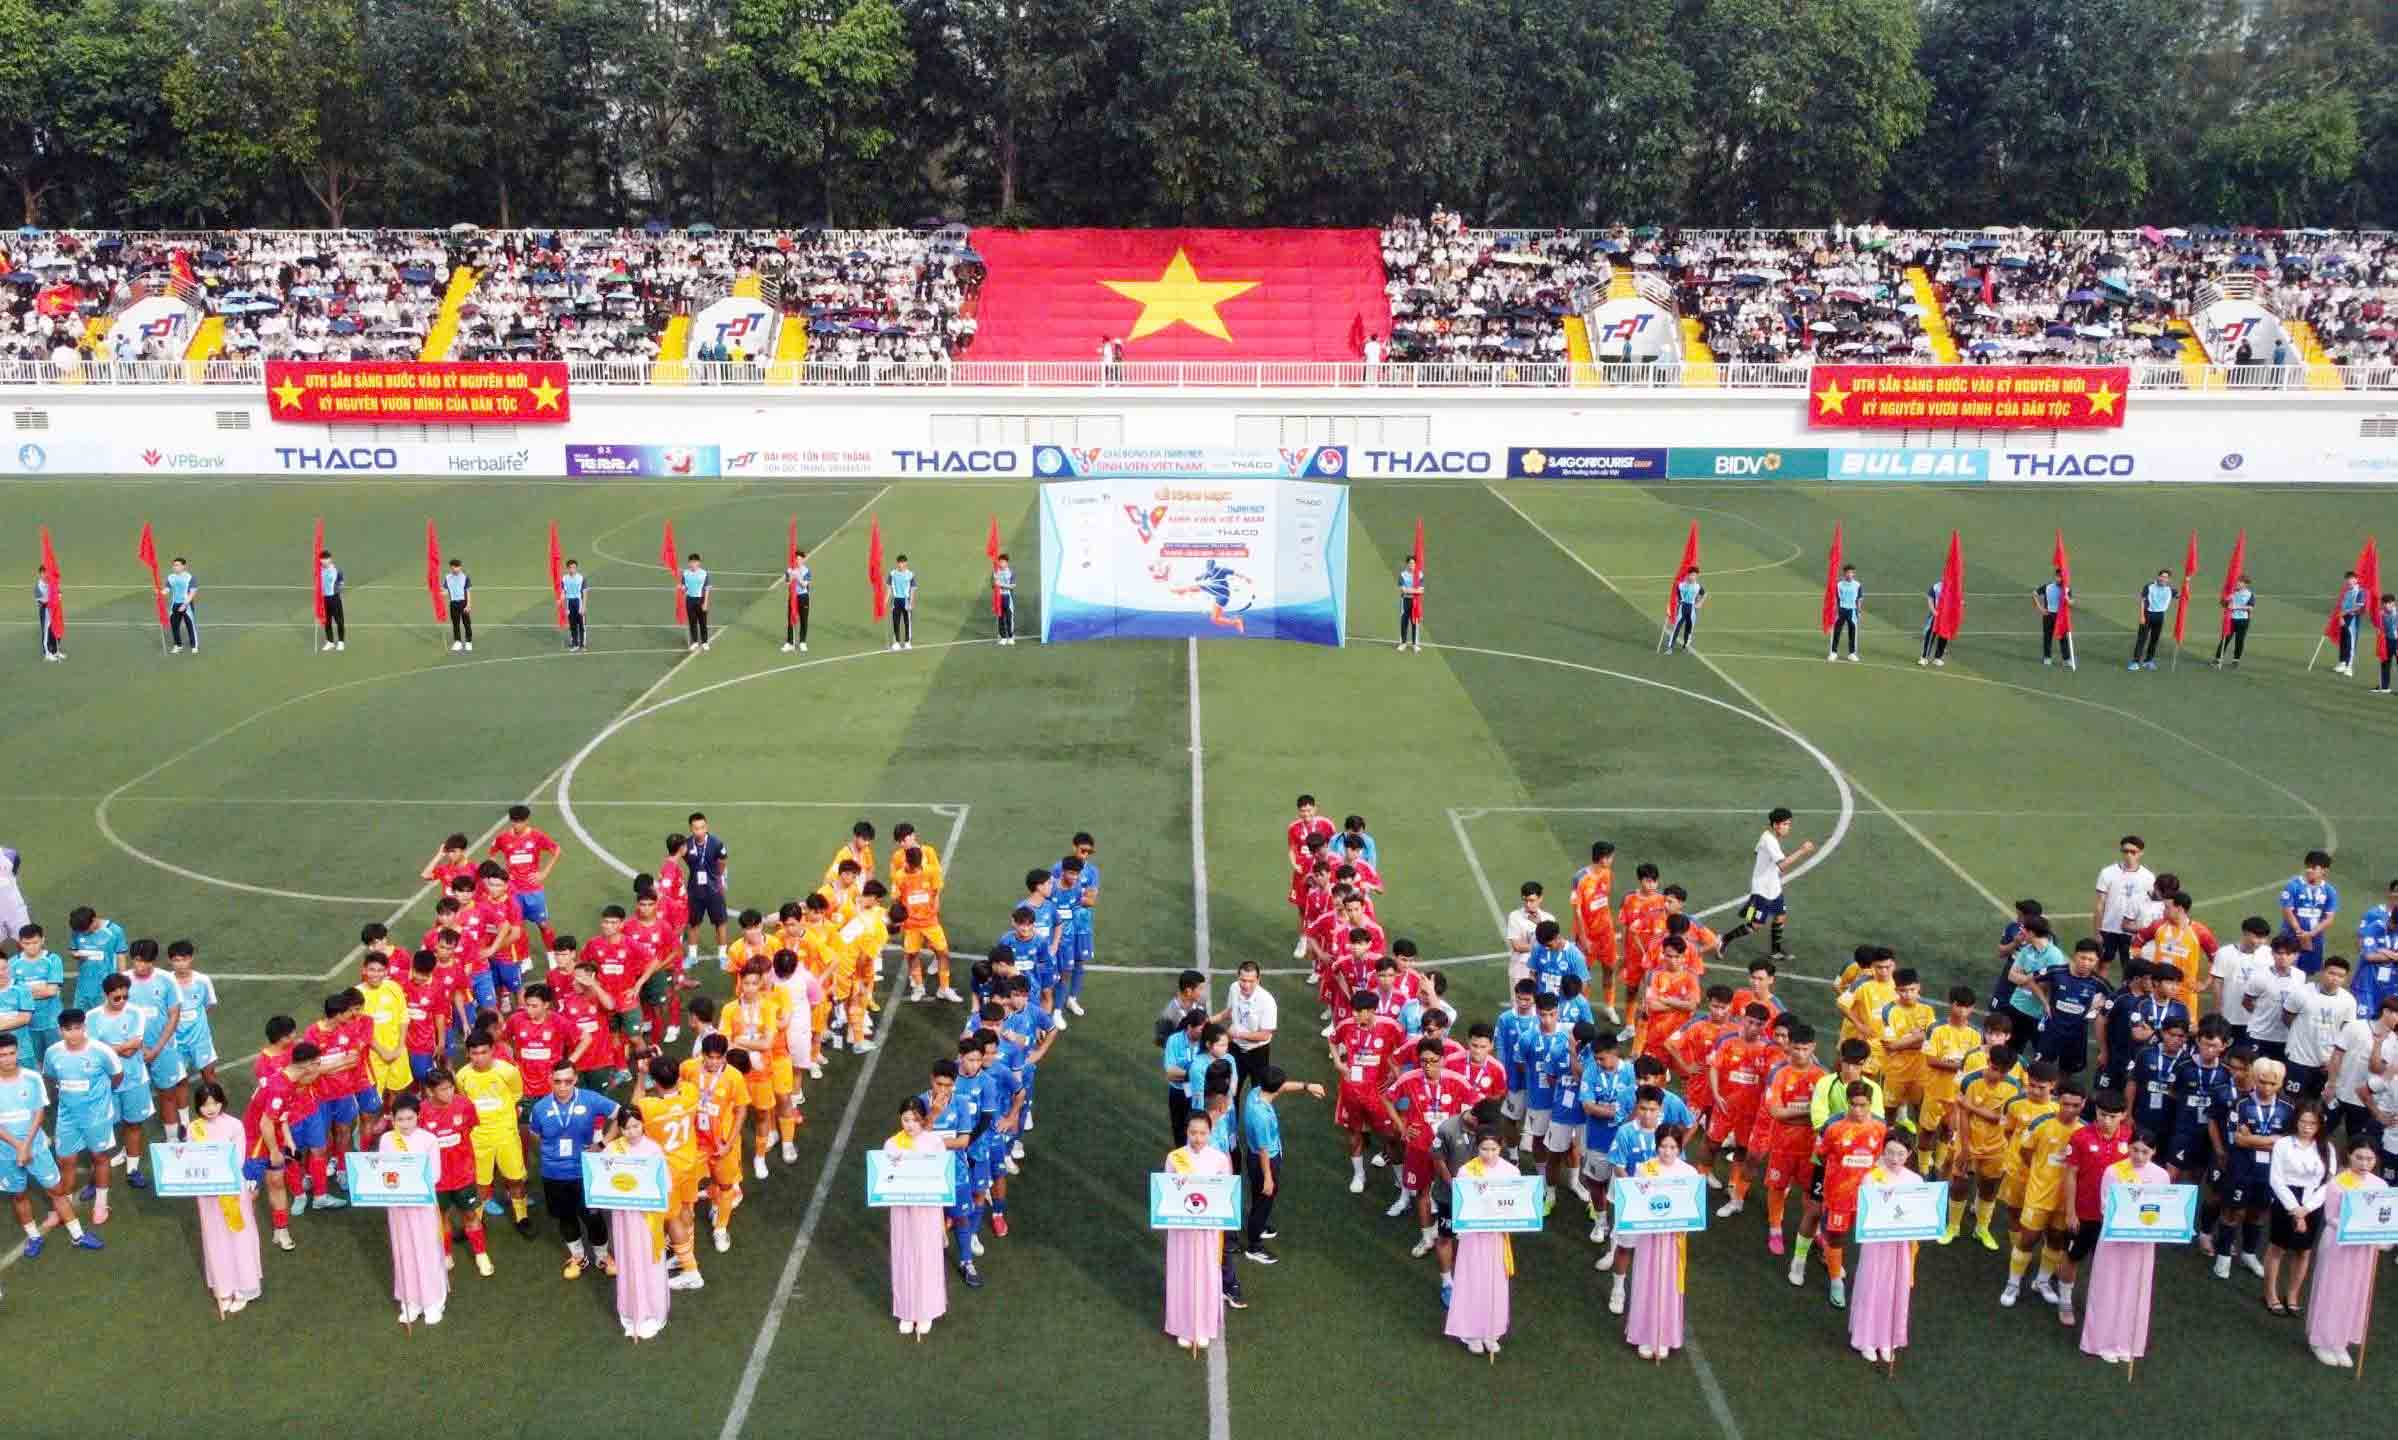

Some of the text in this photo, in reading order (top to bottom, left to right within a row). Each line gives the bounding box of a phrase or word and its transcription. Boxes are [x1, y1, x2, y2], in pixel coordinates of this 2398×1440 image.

[166, 453, 225, 469] VPBank
[274, 447, 398, 470] THACO
[448, 455, 524, 472] Herbalife
[891, 450, 1017, 472] THACO
[1363, 450, 1491, 473] THACO
[1714, 455, 1764, 475] BIDV
[1839, 453, 1977, 475] BULBAL
[2006, 454, 2135, 476] THACO
[663, 1114, 690, 1152] 21
